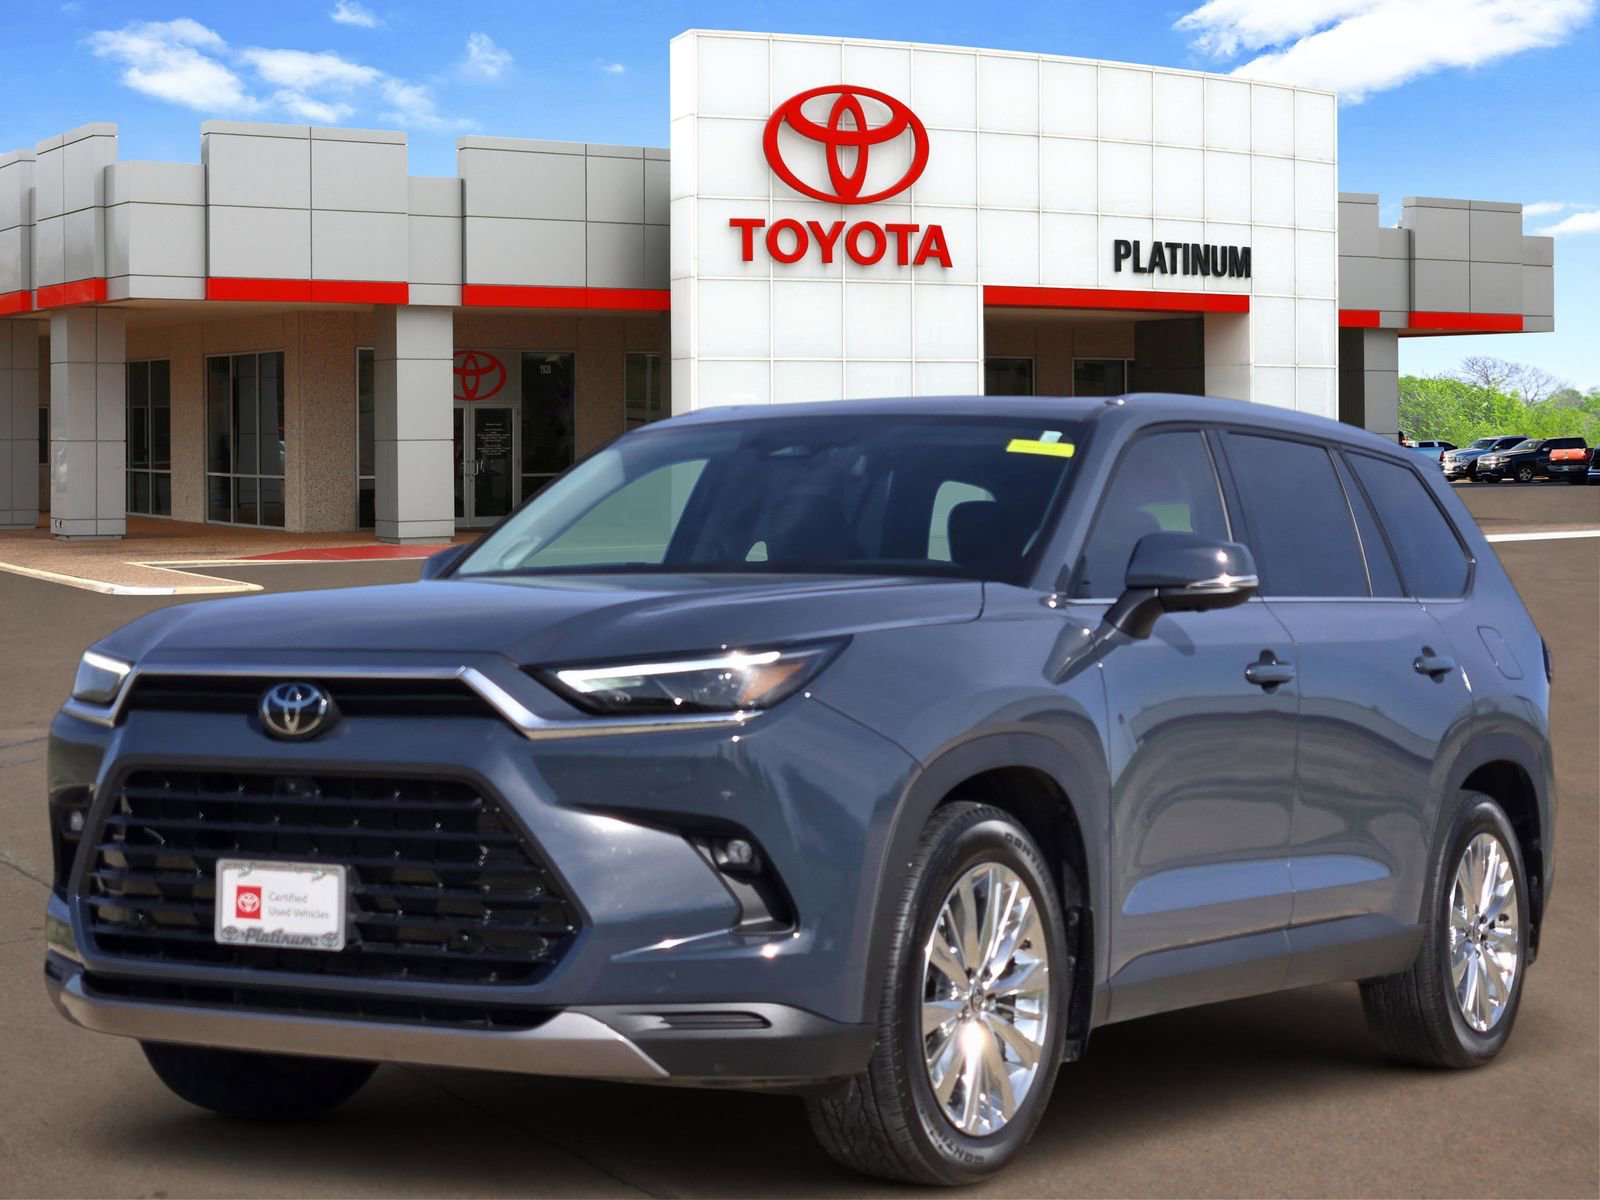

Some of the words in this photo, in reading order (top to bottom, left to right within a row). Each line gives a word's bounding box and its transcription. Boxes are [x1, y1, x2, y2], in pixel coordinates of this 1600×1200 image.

[729, 218, 953, 268] TOYOTA
[1114, 239, 1252, 278] PLATINUM
[268, 891, 308, 903] Certified
[268, 908, 291, 918] Used
[294, 909, 330, 920] Vehicles
[245, 927, 314, 946] Platinum
